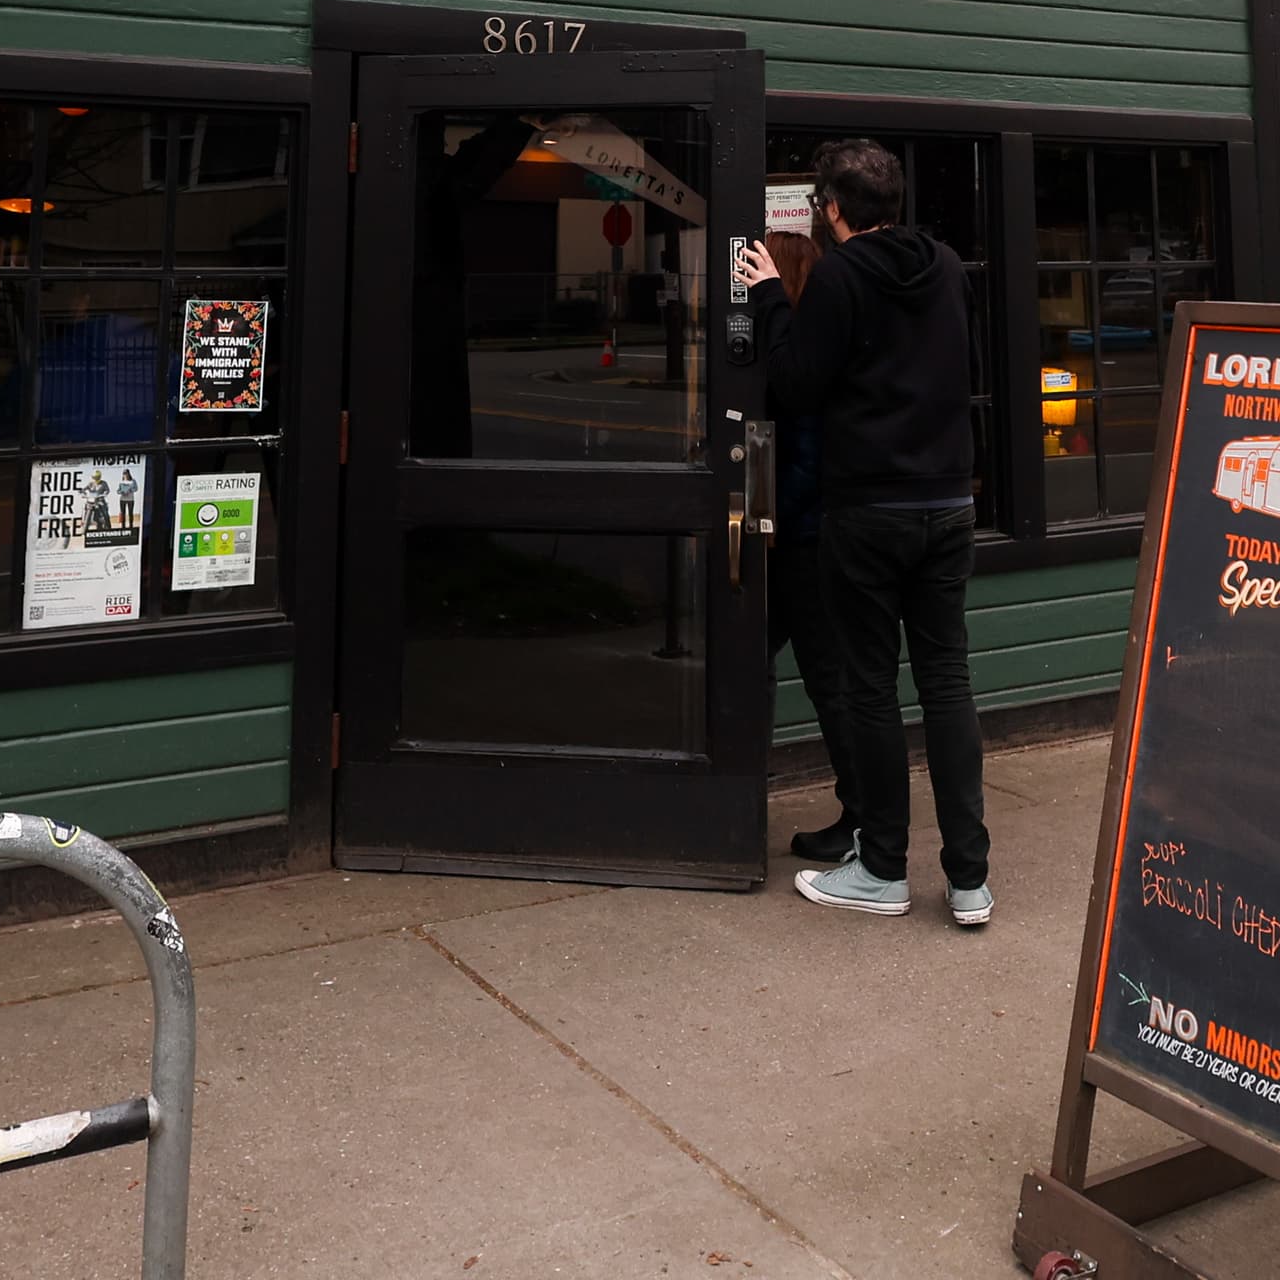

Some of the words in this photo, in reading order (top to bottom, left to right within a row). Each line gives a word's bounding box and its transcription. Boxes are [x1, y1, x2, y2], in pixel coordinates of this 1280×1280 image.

[482, 16, 586, 55] 8617
[585, 145, 686, 206] LORETTA'S
[772, 207, 810, 219] MINORS
[200, 336, 216, 346] WE
[218, 336, 250, 346] STAND
[211, 347, 238, 357] WITH
[195, 358, 251, 368] IMMIGRANT
[201, 369, 244, 379] FAMILIES
[40, 471, 83, 493] RIDE
[215, 478, 255, 490] RATING
[39, 495, 74, 516] FOR
[222, 508, 240, 518] GOOD
[37, 517, 83, 539] FREE
[105, 596, 133, 605] RIDE
[106, 605, 131, 615] DAY
[1141, 858, 1225, 930] BROCCOLI
[1148, 995, 1199, 1043] NO
[1137, 1022, 1160, 1048] YOU
[1156, 1034, 1185, 1057] MUST
[1181, 1044, 1198, 1063] BE
[1195, 1050, 1208, 1068] 21
[1207, 1054, 1239, 1083] YEARS
[1239, 1071, 1257, 1092] OR
